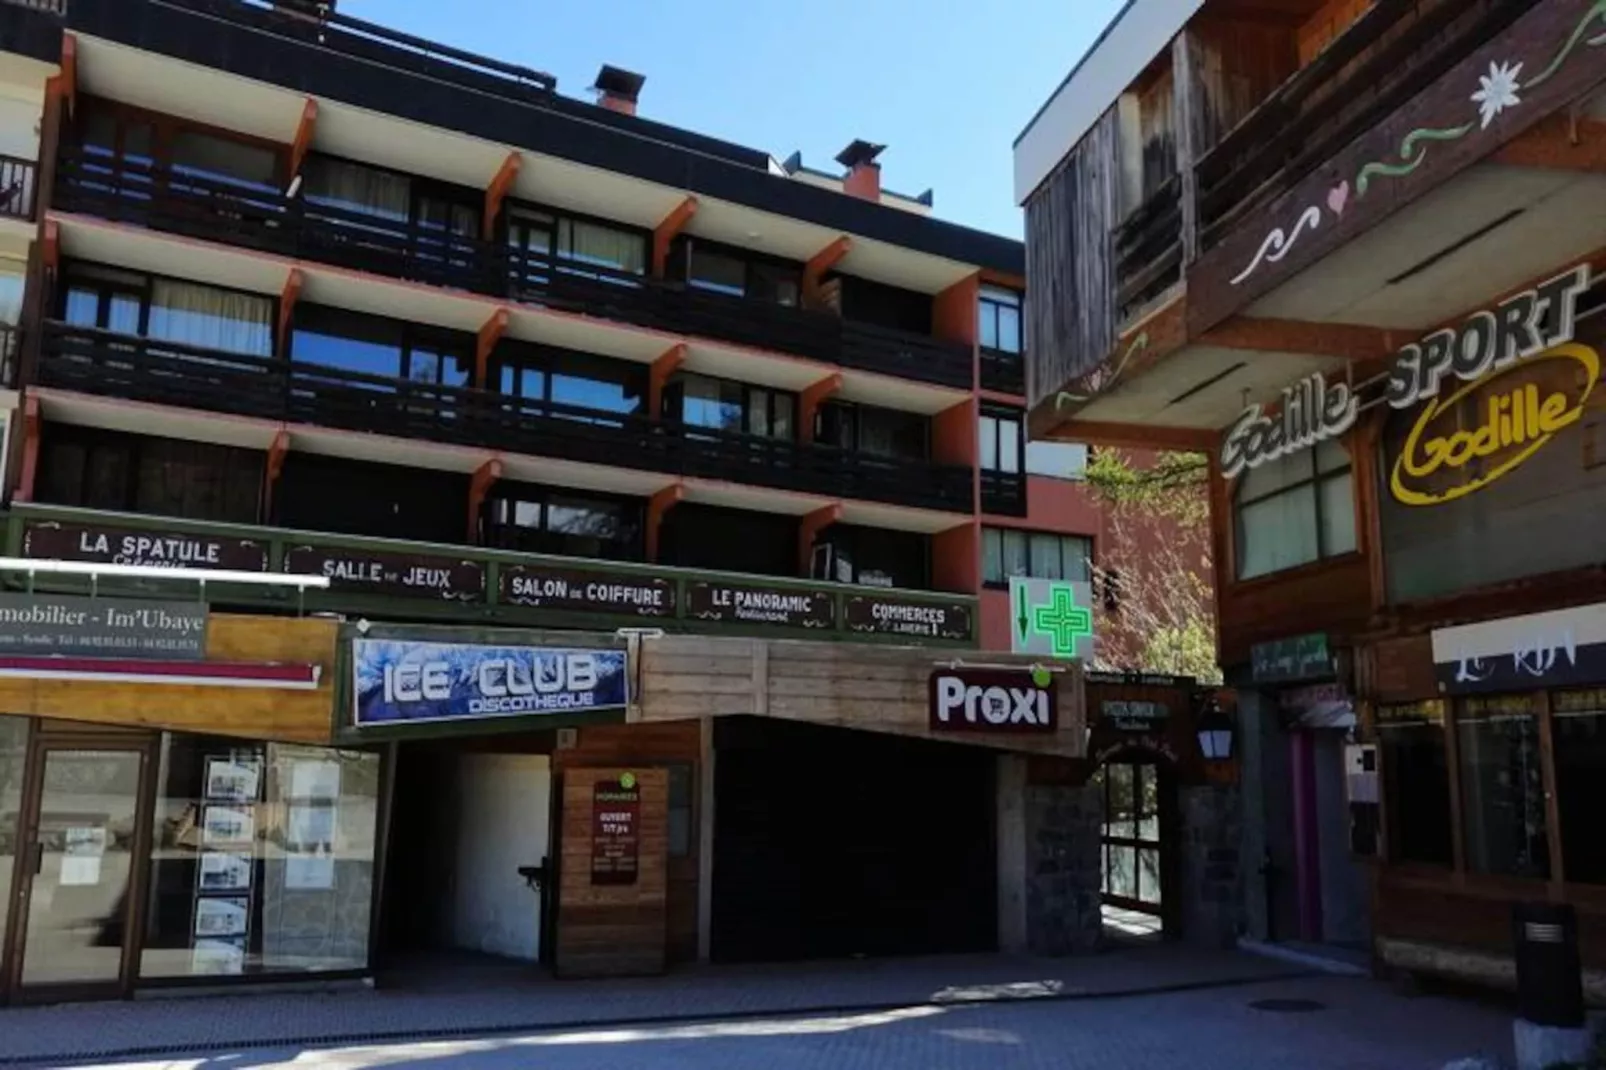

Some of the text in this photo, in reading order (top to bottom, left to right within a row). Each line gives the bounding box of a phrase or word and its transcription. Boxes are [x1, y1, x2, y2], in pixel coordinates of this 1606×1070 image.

[1385, 262, 1592, 409] SPORT
[1220, 373, 1359, 479] Godille
[1403, 384, 1582, 478] Godille
[80, 531, 220, 563] LA SPATULE
[323, 559, 383, 582] SALLE
[403, 567, 451, 588] JEUX
[512, 576, 567, 598] SALON
[586, 584, 662, 606] COIFFURE
[712, 589, 812, 612] LE PANORAMIC
[107, 608, 204, 636] Im'Ubaye
[872, 603, 945, 624] COMMERCES
[384, 653, 598, 703] ICE CLUB
[936, 675, 1050, 725] Proxi
